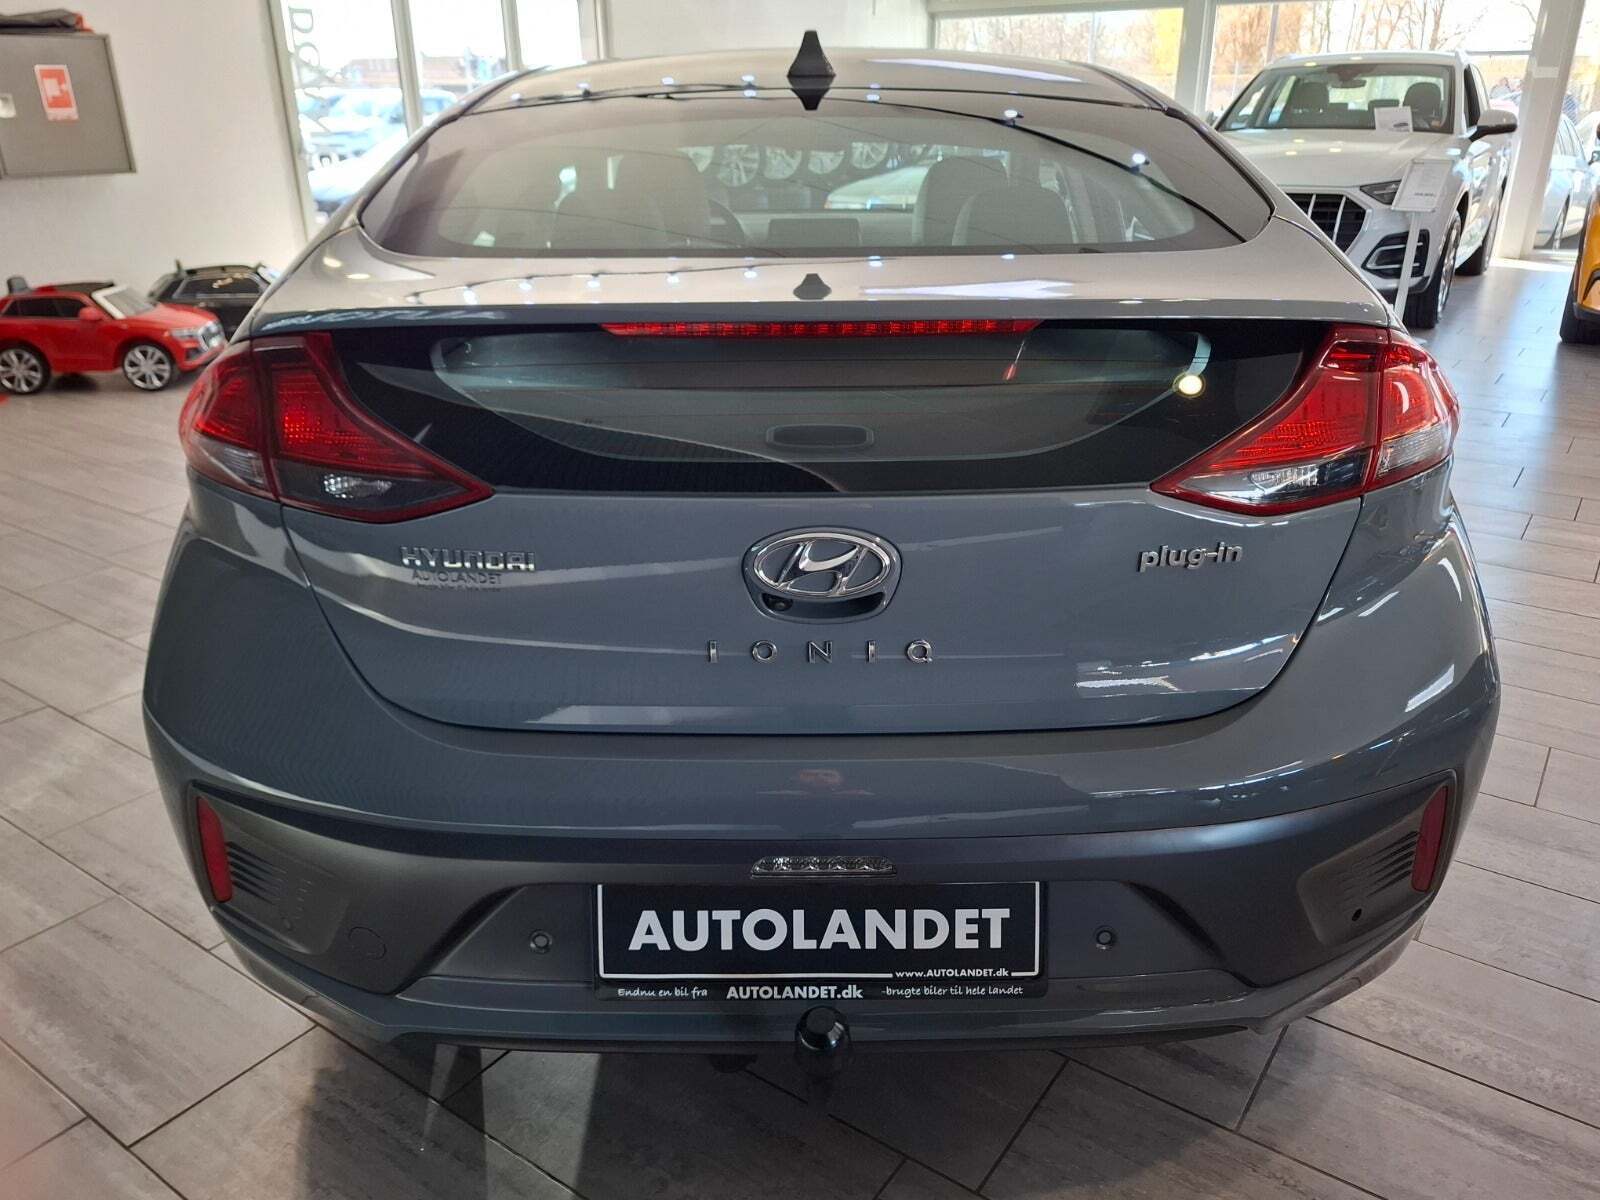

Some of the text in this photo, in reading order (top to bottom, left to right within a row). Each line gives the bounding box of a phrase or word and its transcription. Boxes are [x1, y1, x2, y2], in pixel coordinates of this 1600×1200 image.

[401, 546, 536, 571] HYUNDAI
[1137, 541, 1243, 573] plug-in
[412, 569, 502, 584] AUTOLANDET
[707, 639, 934, 665] IONIQ
[628, 907, 1011, 952] AUTOLANDET
[895, 967, 1009, 979] www.AUTOLANDET.dk
[617, 988, 655, 998] Endnu
[659, 990, 673, 998] en
[674, 987, 689, 998] bil
[691, 988, 708, 1000] fra
[726, 985, 863, 1000] AUTOLANDET.dk
[924, 984, 947, 997] biler
[949, 984, 963, 996] til
[965, 984, 986, 996] hele
[988, 984, 1024, 996] landet
